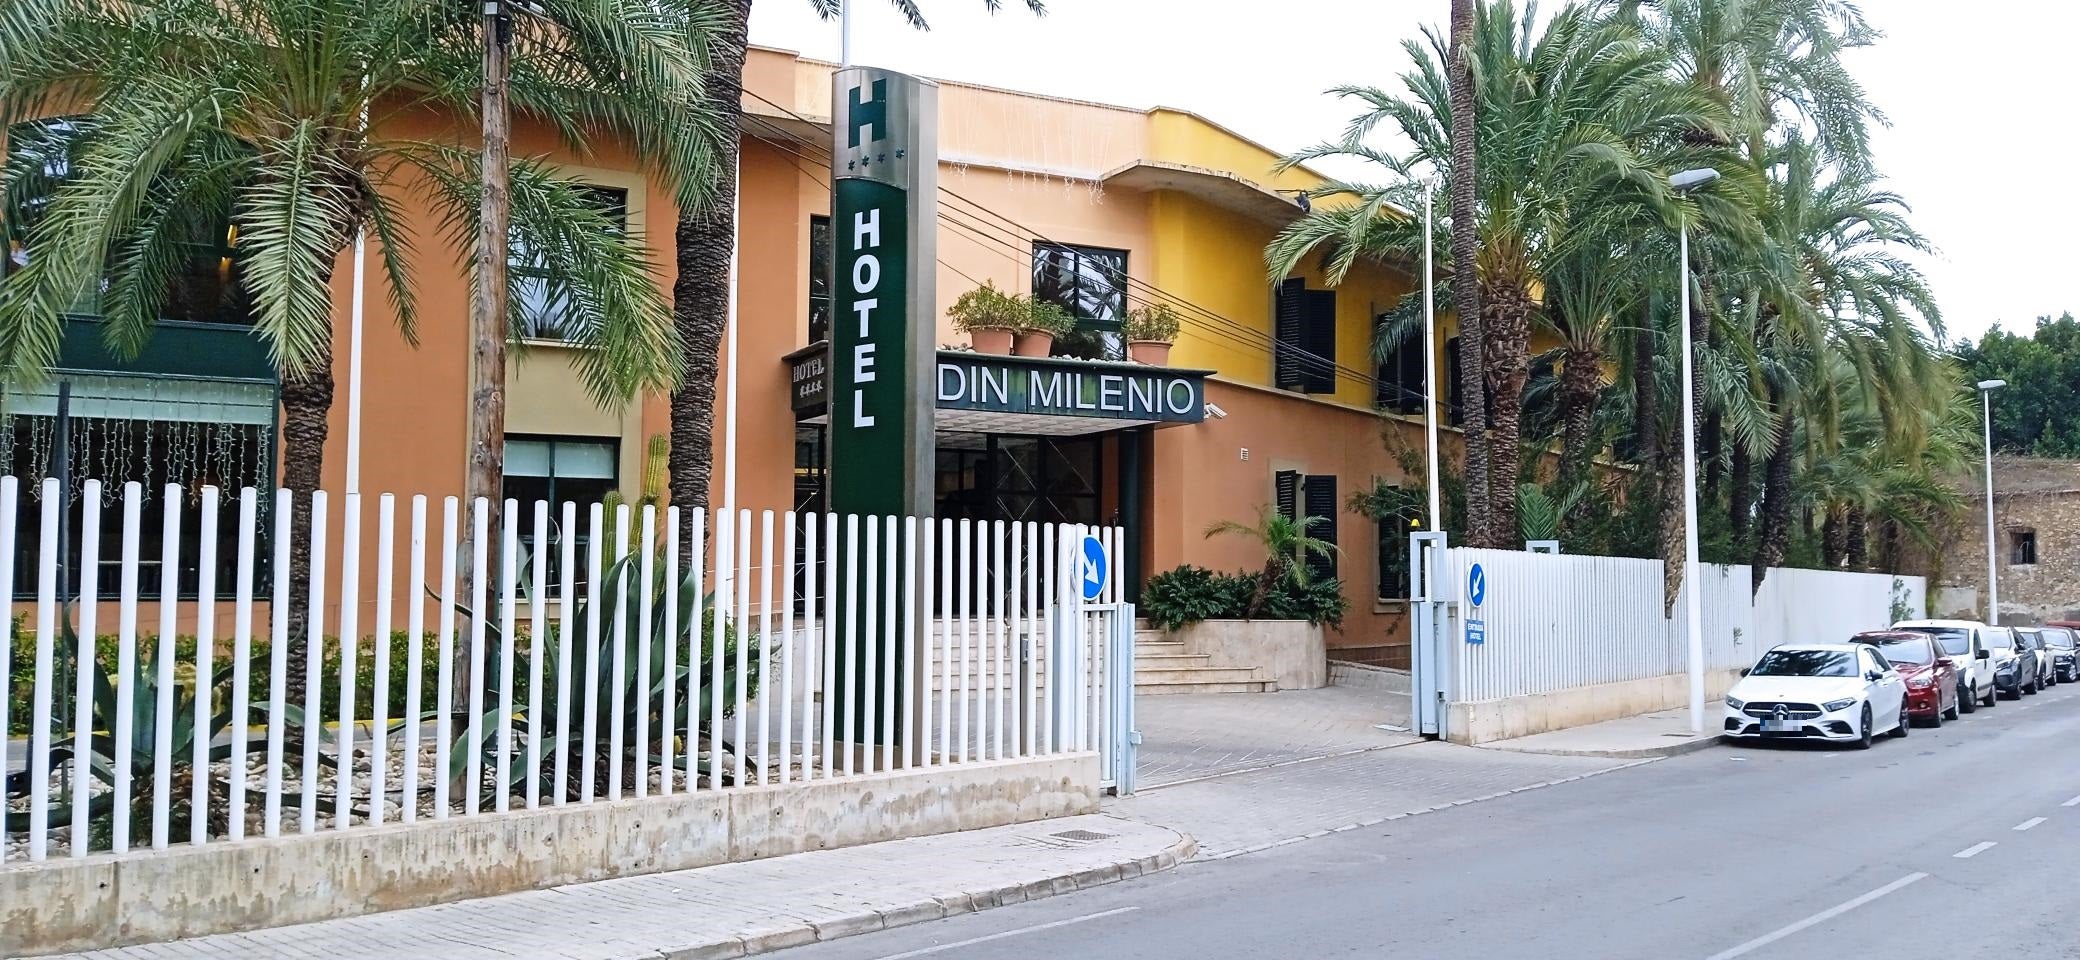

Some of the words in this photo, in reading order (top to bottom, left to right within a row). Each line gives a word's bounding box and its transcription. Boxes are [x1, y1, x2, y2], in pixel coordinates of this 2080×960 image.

[848, 78, 887, 149] H
[852, 208, 880, 428] HOTEL
[793, 358, 825, 383] HOTEL
[1030, 370, 1195, 415] MILENIO
